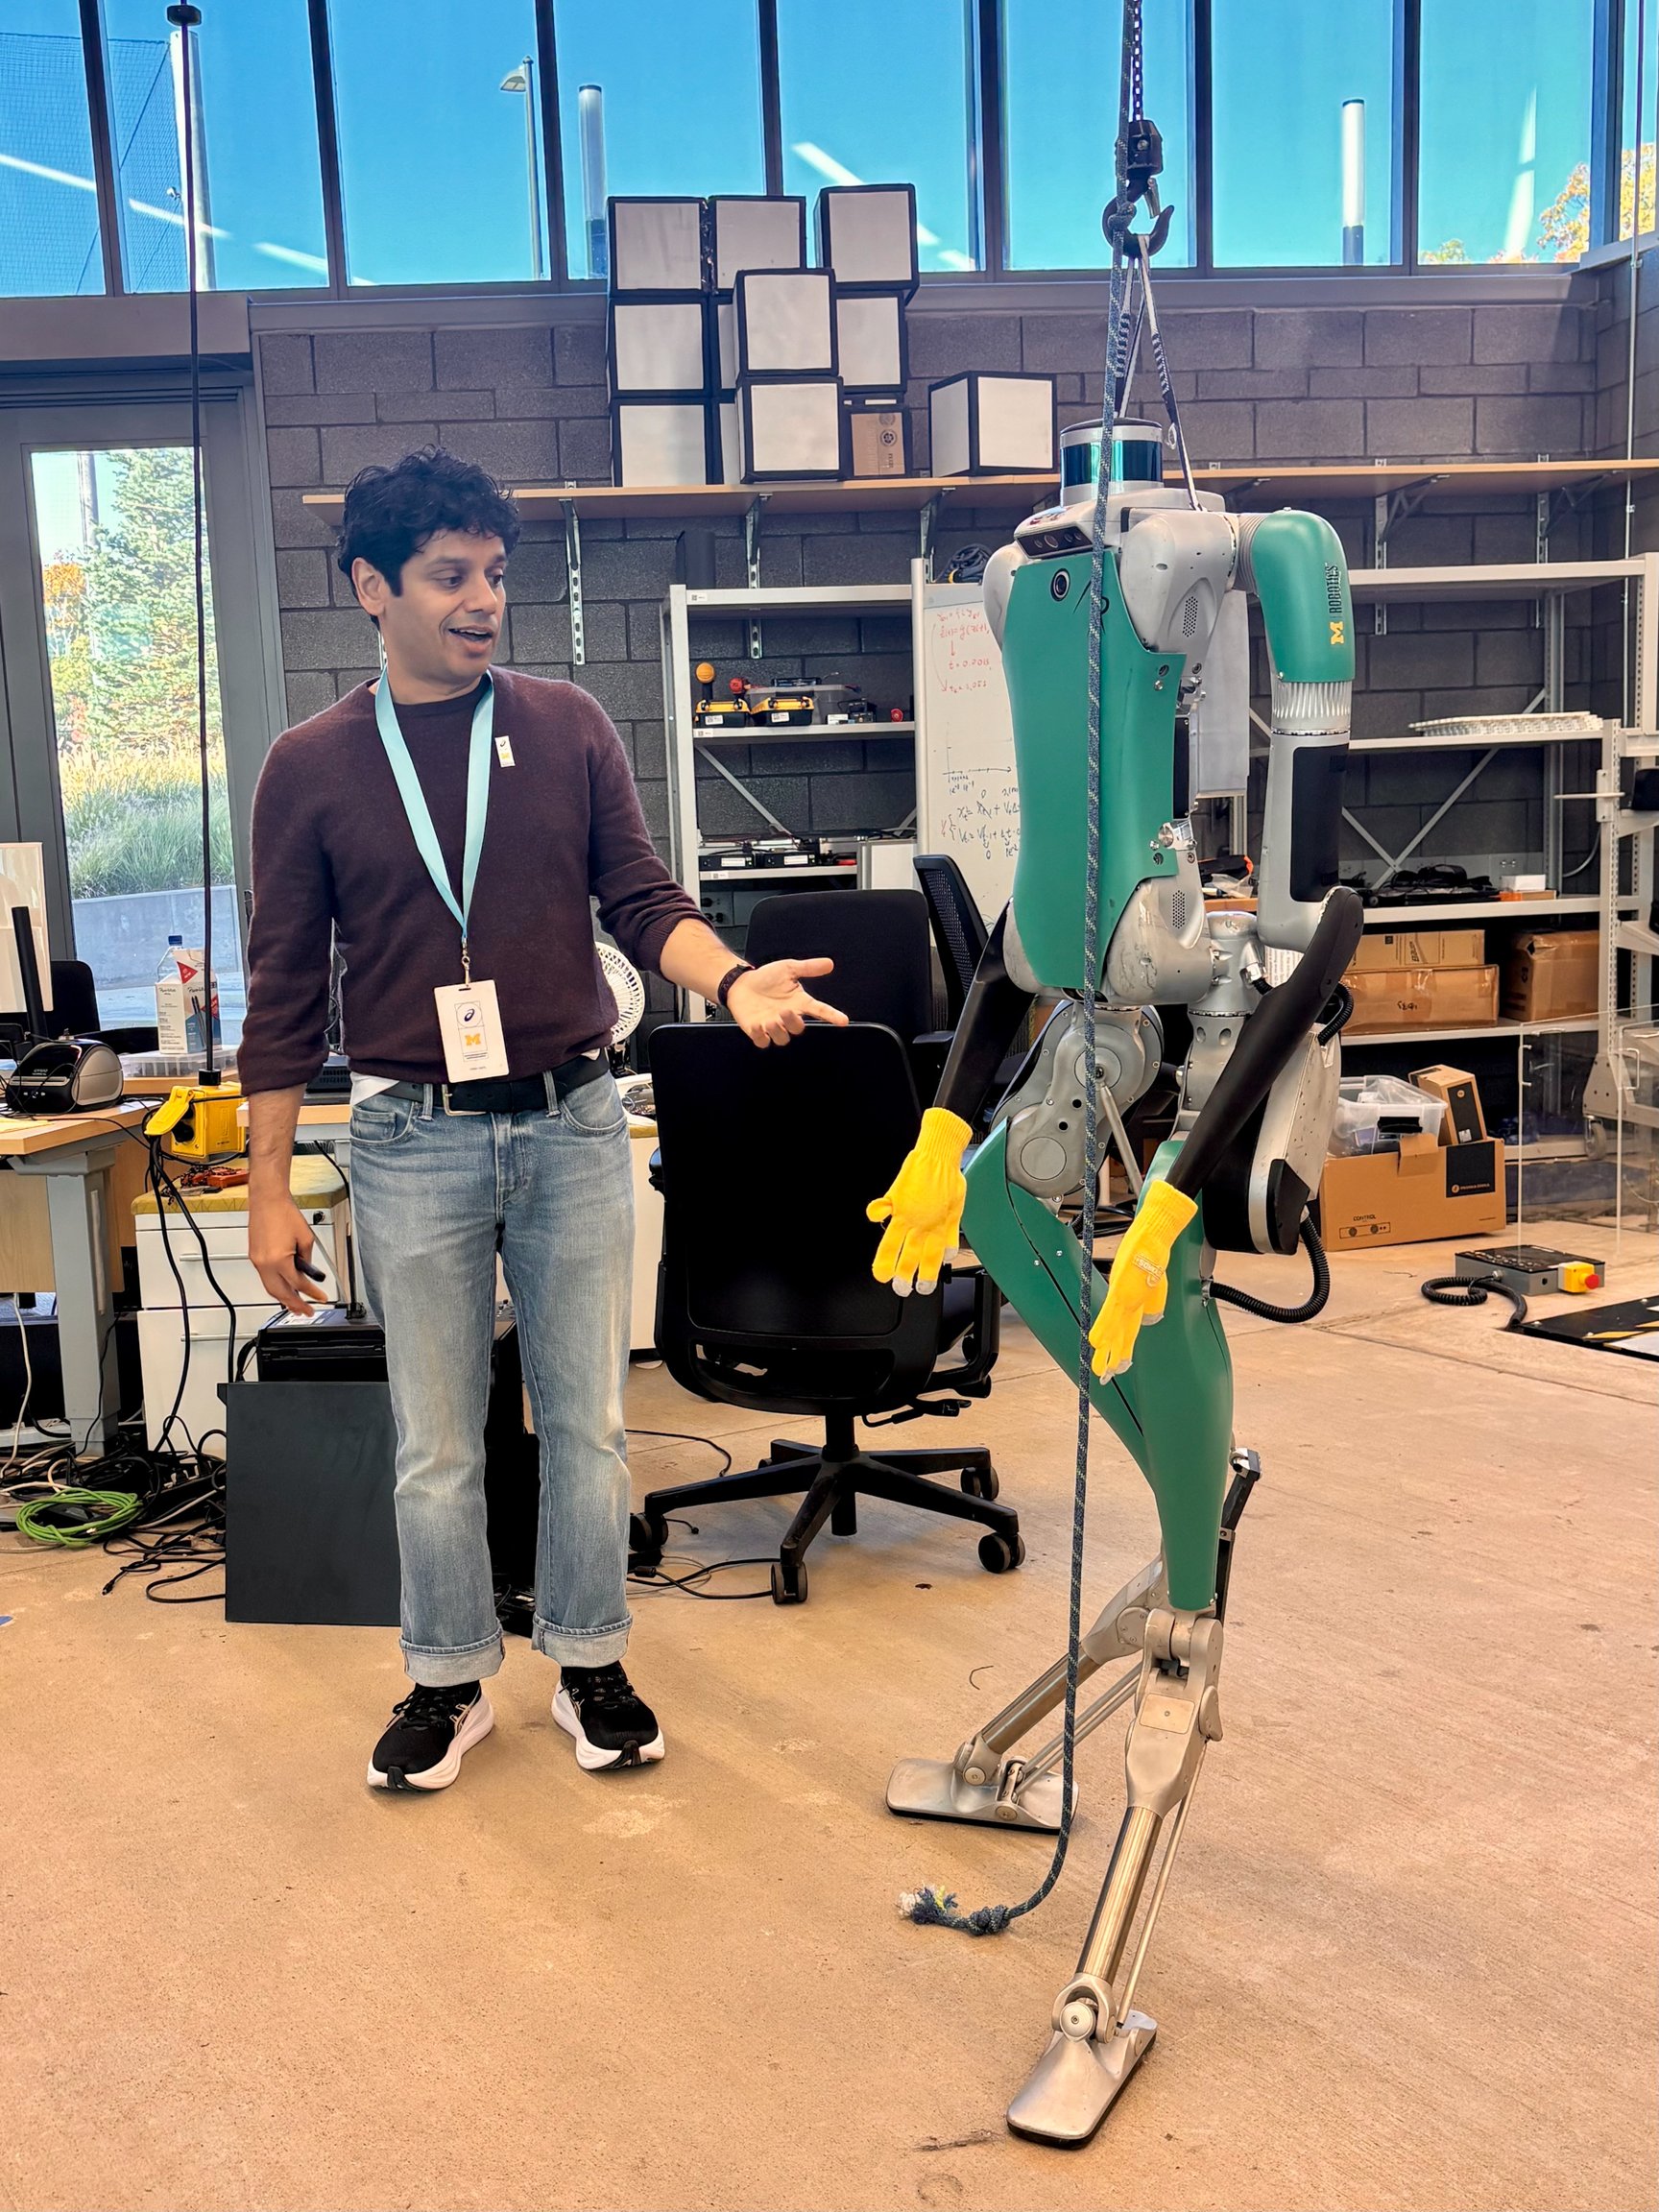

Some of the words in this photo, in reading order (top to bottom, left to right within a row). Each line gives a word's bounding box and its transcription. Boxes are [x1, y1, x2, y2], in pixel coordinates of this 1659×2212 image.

[1325, 565, 1342, 613] ROBOTICS
[1329, 620, 1345, 645] M
[465, 1033, 481, 1046] M
[1353, 1214, 1377, 1222] CONTROL
